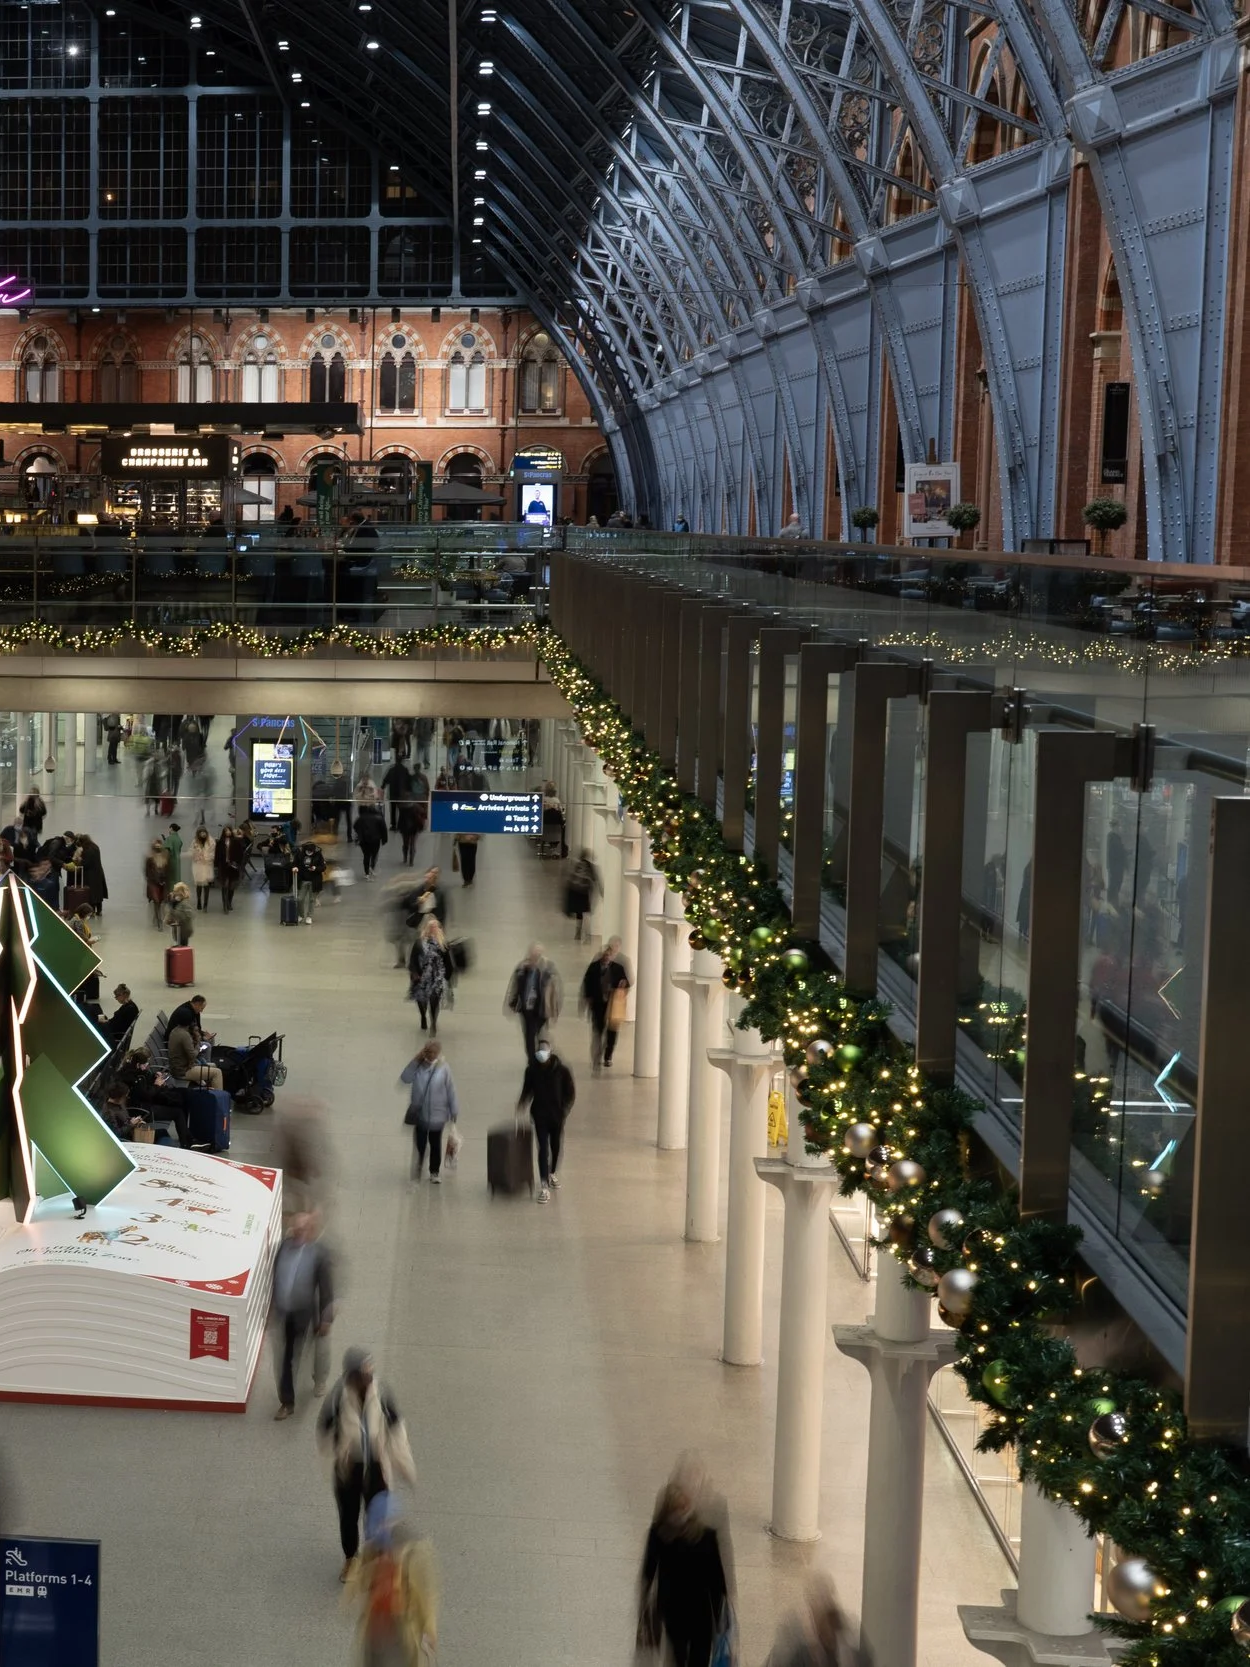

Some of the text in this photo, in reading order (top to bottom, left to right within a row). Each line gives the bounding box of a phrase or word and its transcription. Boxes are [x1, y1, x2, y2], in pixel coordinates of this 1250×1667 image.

[130, 448, 189, 457] BRASSERIE
[121, 458, 209, 466] CHAMPAGNE BAR
[490, 794, 530, 802] Underground
[130, 1212, 163, 1224] 3
[120, 1233, 150, 1246] 2
[6, 1570, 92, 1586] Platforms 1-4
